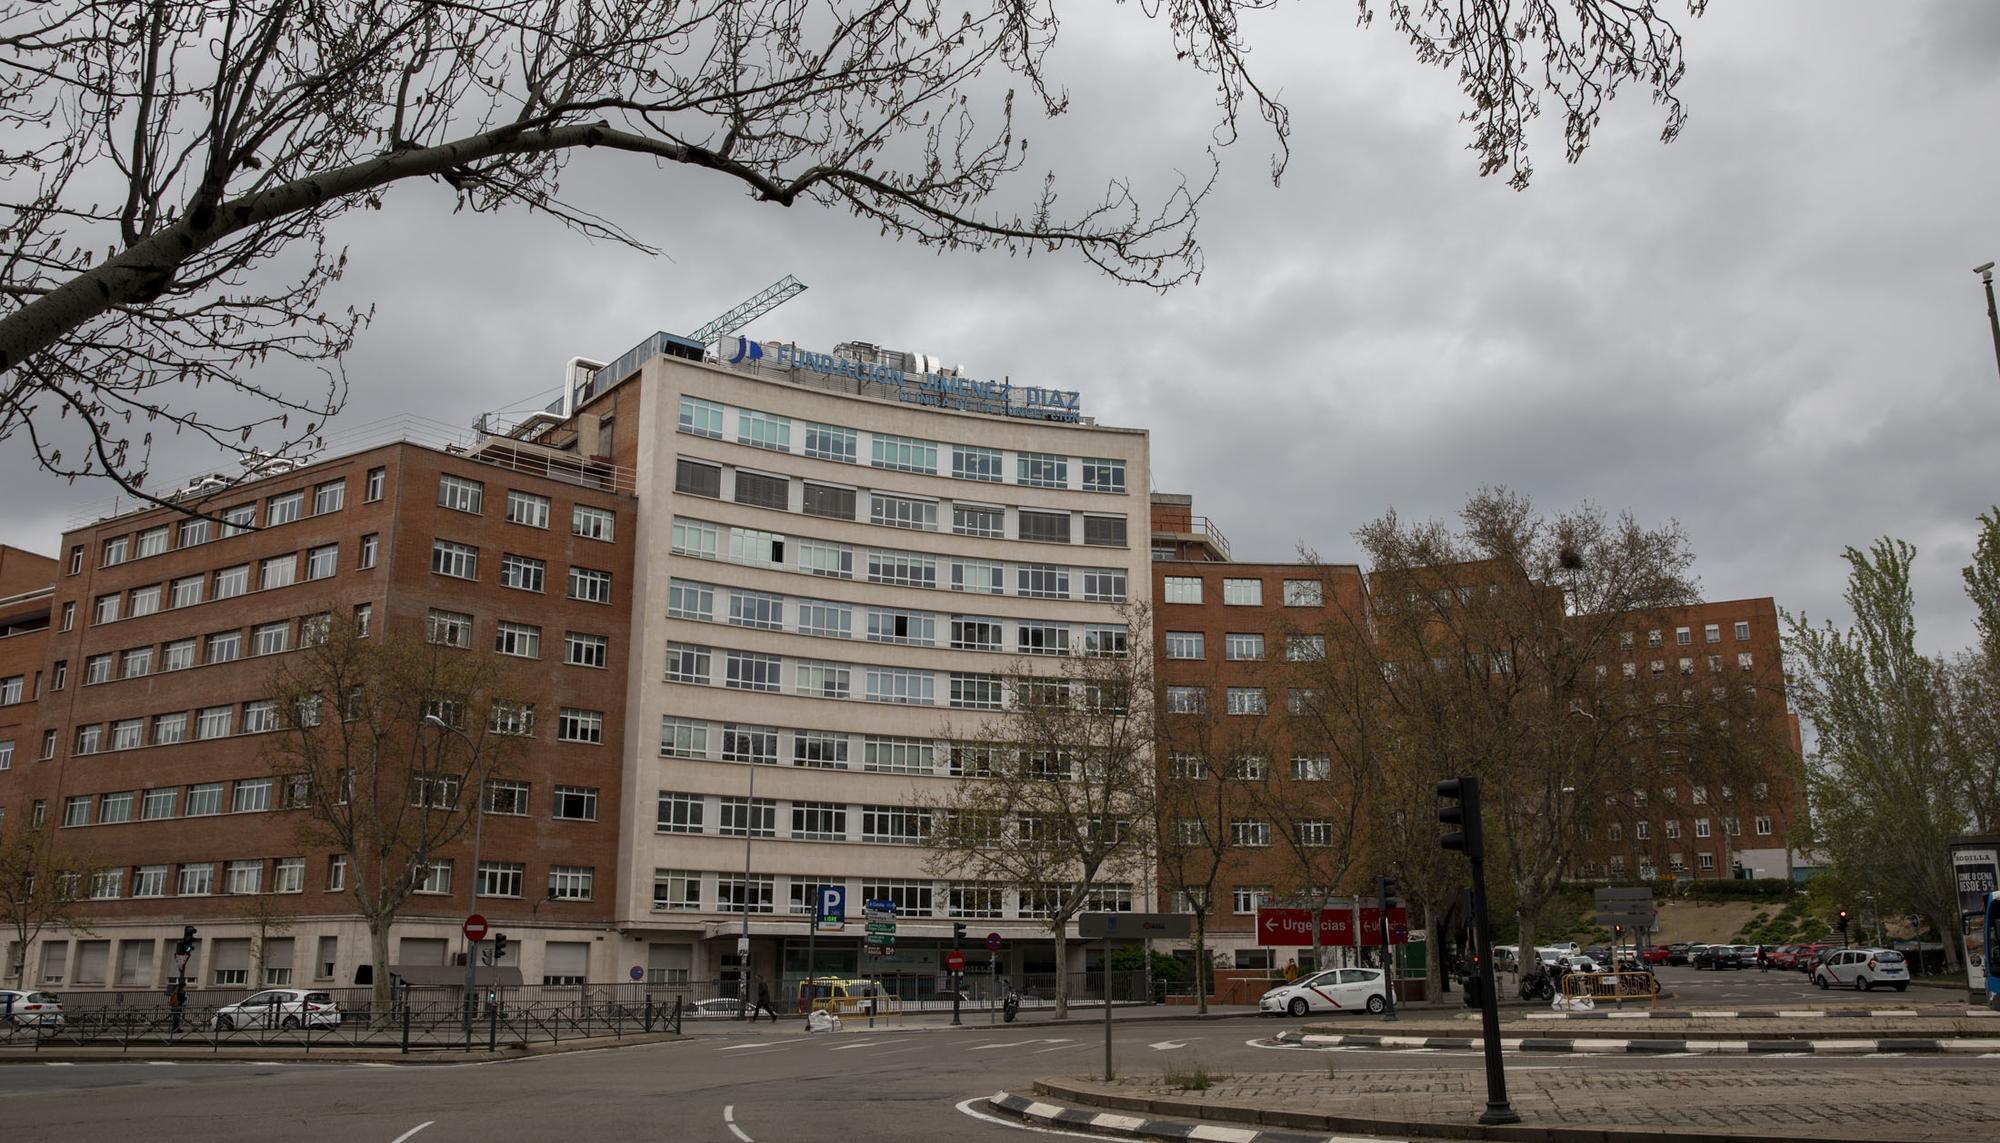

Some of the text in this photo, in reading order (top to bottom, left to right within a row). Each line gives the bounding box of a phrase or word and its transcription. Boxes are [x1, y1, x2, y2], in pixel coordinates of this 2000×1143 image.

[1027, 385, 1080, 409] DIAZ
[823, 890, 841, 916] P
[1282, 918, 1346, 933] Urgecias
